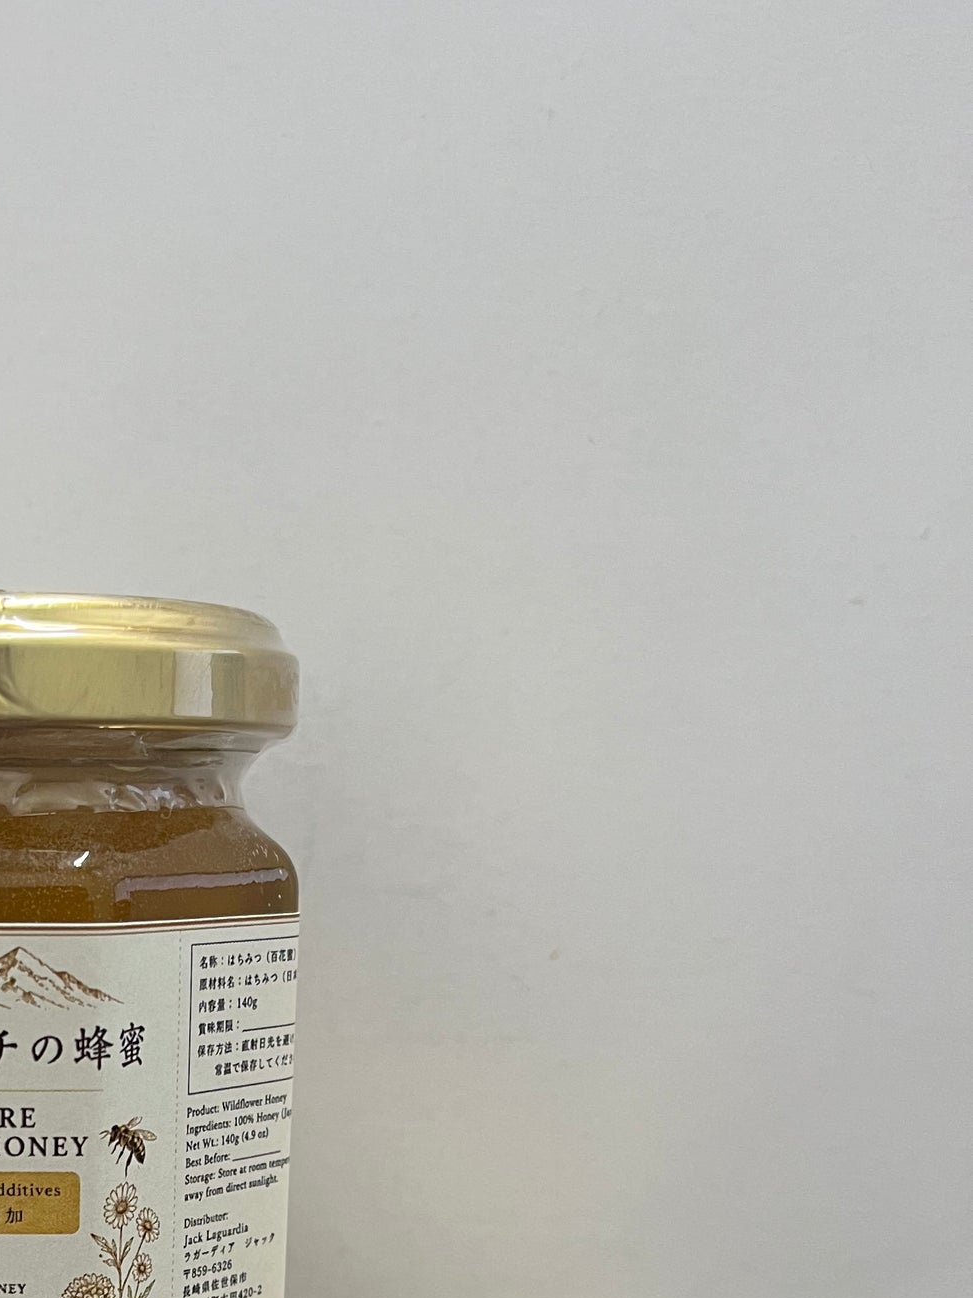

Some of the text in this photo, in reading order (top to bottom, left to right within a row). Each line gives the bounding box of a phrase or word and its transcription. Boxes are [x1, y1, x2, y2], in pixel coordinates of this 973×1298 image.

[187, 1094, 287, 1119] Product: Wildflower Honey
[186, 1120, 231, 1137] Ingredients:
[234, 1113, 254, 1127] 100%
[256, 1111, 280, 1123] Honey
[186, 1141, 200, 1152] Net
[221, 1133, 239, 1146] 140g
[186, 1152, 230, 1169] Best Before:
[185, 1173, 216, 1185] Storage:
[218, 1167, 237, 1179] Store
[239, 1165, 247, 1174] at
[248, 1162, 267, 1173] room
[184, 1192, 204, 1202] away
[206, 1186, 224, 1198] from
[226, 1180, 247, 1193] direct
[184, 1212, 229, 1229] Distributor:
[183, 1223, 249, 1248] Jack Laguardia
